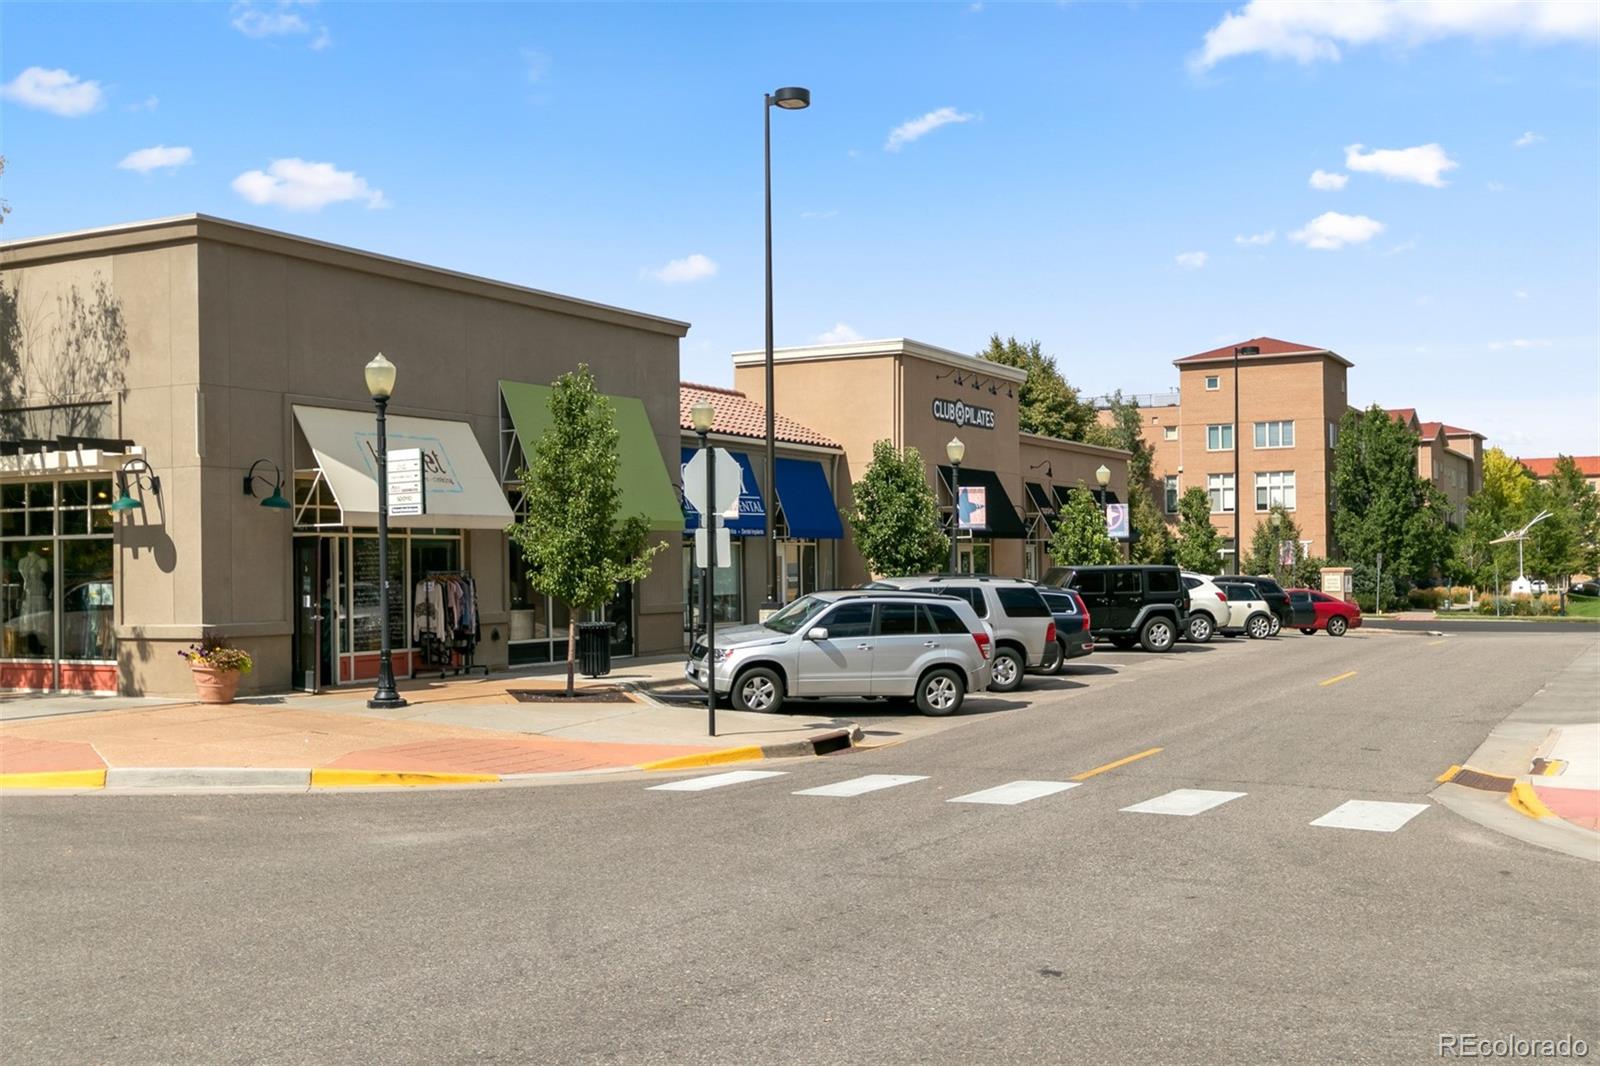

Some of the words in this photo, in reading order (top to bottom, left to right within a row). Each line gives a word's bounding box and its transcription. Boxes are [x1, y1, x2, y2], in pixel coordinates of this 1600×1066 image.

[934, 400, 955, 420] CLUB
[965, 407, 995, 427] PILATES
[739, 501, 764, 513] ENTAL
